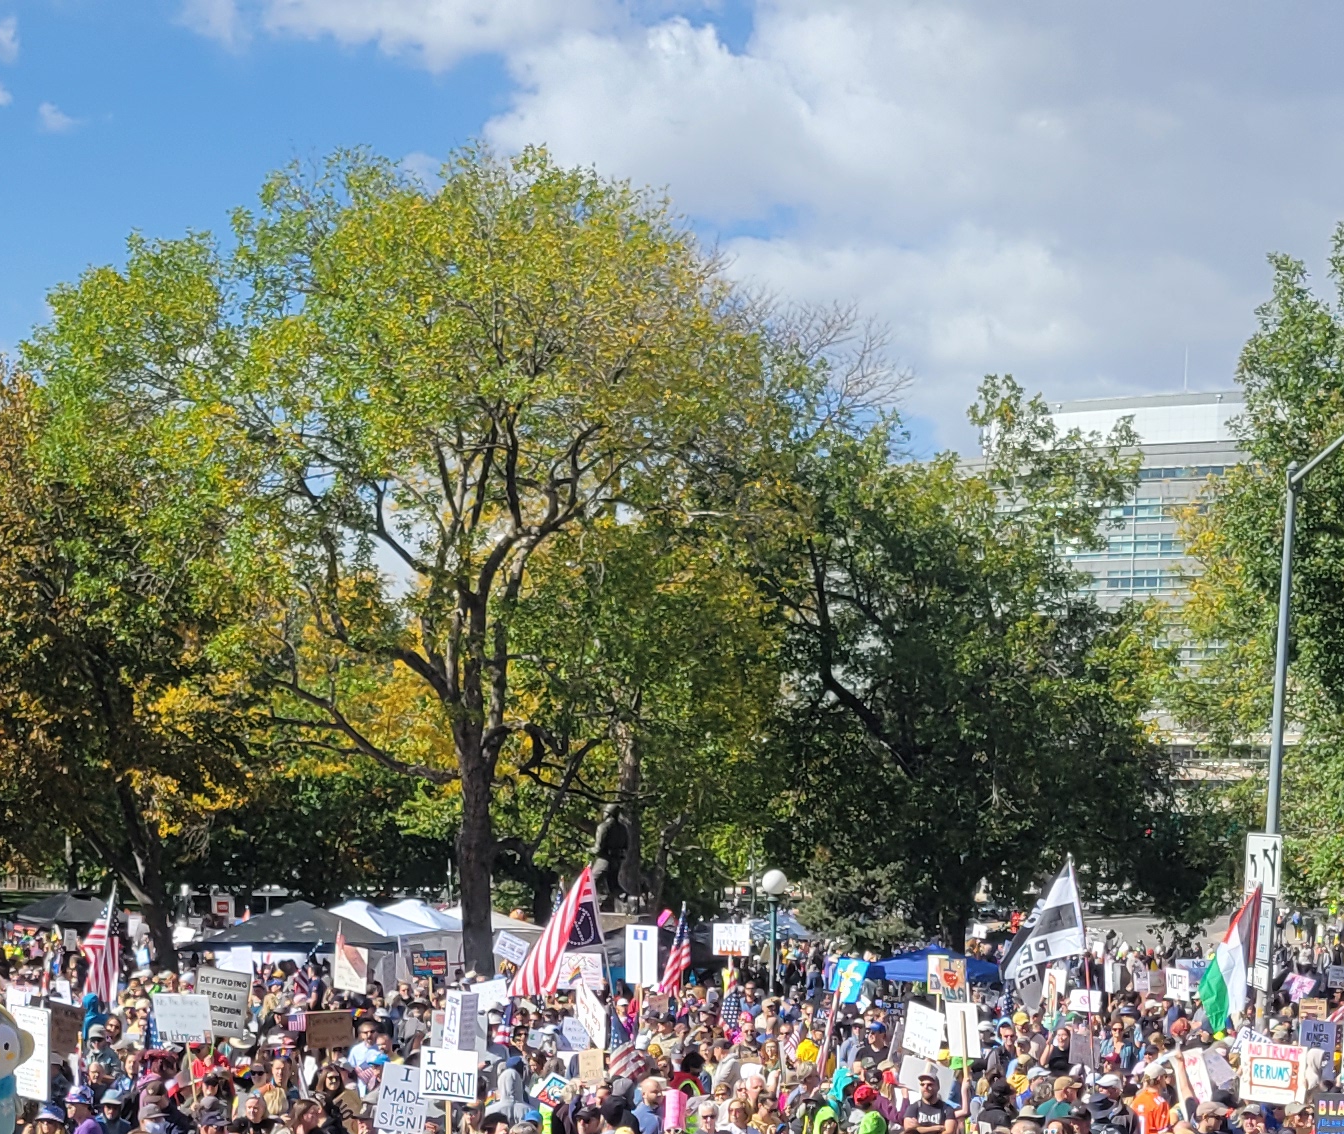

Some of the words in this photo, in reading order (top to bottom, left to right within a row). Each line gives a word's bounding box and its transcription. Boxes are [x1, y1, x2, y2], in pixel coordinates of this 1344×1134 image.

[200, 976, 247, 989] DEFUNDING
[201, 990, 237, 1001] SPECIAL
[210, 1006, 241, 1016] CATION
[212, 1020, 238, 1029] CRUEL
[1313, 1023, 1324, 1032] NO
[1306, 1033, 1329, 1043] KINGS
[427, 1050, 436, 1065] I
[1248, 1043, 1263, 1055] NO
[1266, 1044, 1304, 1060] TRUMP
[400, 1068, 412, 1083] I
[1253, 1063, 1291, 1081] RERUNS
[425, 1069, 475, 1096] DISSENT!
[383, 1085, 427, 1105] MADE
[390, 1103, 414, 1115] THIS
[378, 1112, 423, 1133] SIGN!
